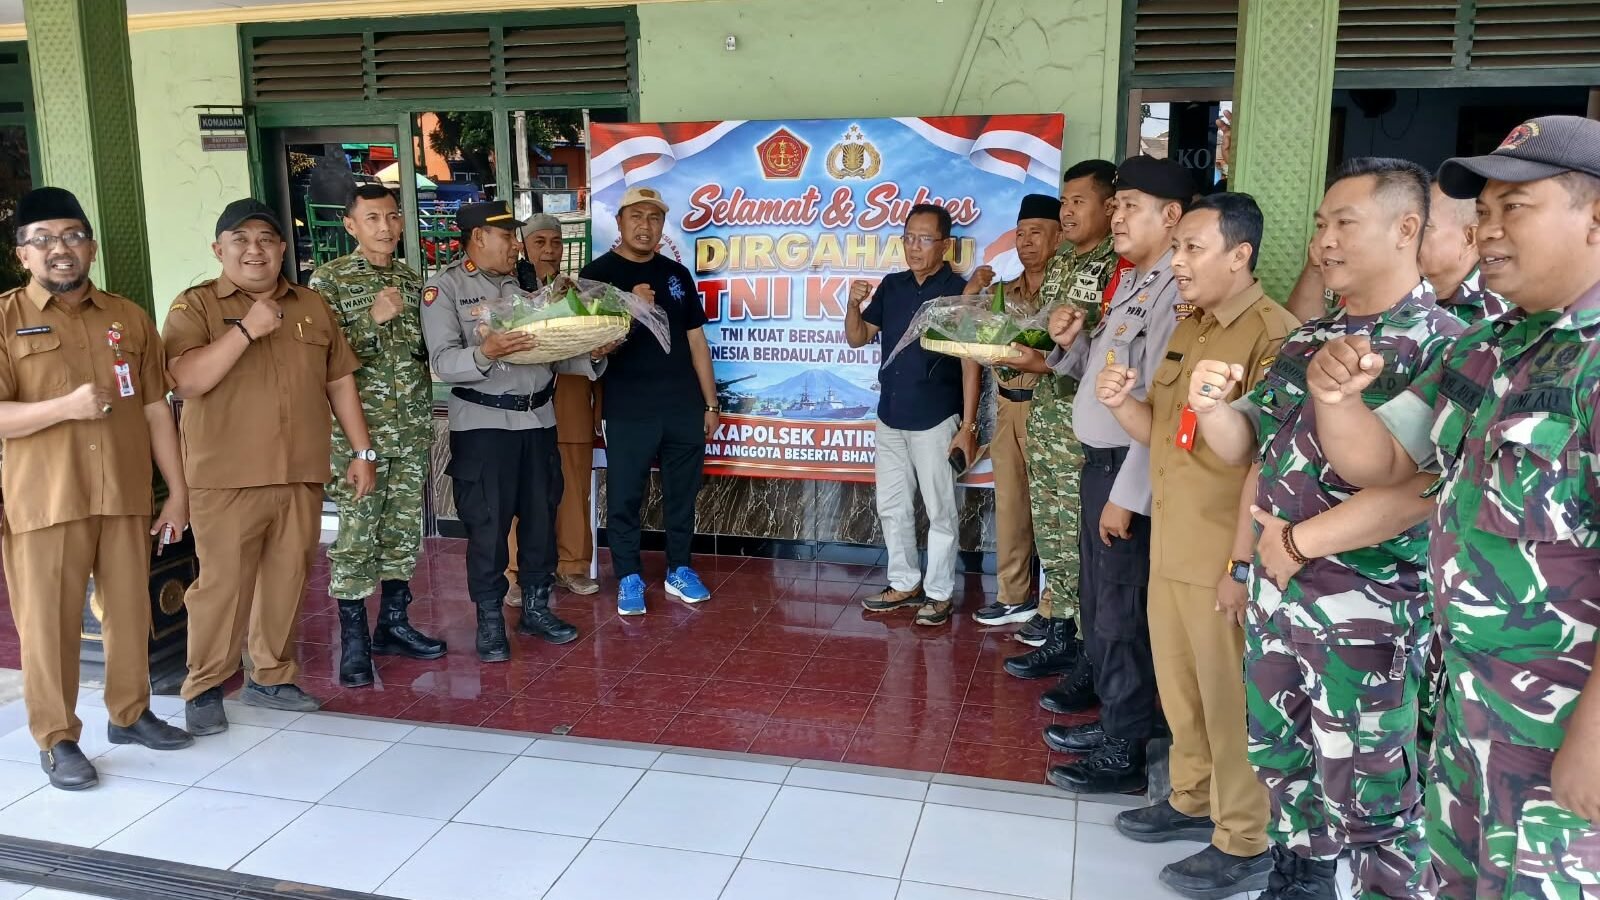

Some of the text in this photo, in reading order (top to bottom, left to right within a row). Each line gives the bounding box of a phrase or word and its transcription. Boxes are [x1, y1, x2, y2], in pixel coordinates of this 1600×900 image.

[202, 118, 243, 127] KOMANDAN
[682, 183, 980, 231] Selamat & Sues
[696, 232, 976, 273] DIRGAHAU
[343, 296, 373, 309] WAHYU
[459, 297, 479, 306] IMAM
[698, 276, 791, 321] TNI
[1071, 288, 1097, 301] TNI AD
[720, 327, 848, 344] TNI KUAT BERSAM
[710, 346, 750, 361] NESIA
[753, 347, 834, 363] BERDAULAT
[837, 350, 868, 364] ADIL
[712, 423, 876, 448] KAPOLSEK JATIR
[704, 443, 876, 463] AN ANGGOTA BESERTA BHAY
